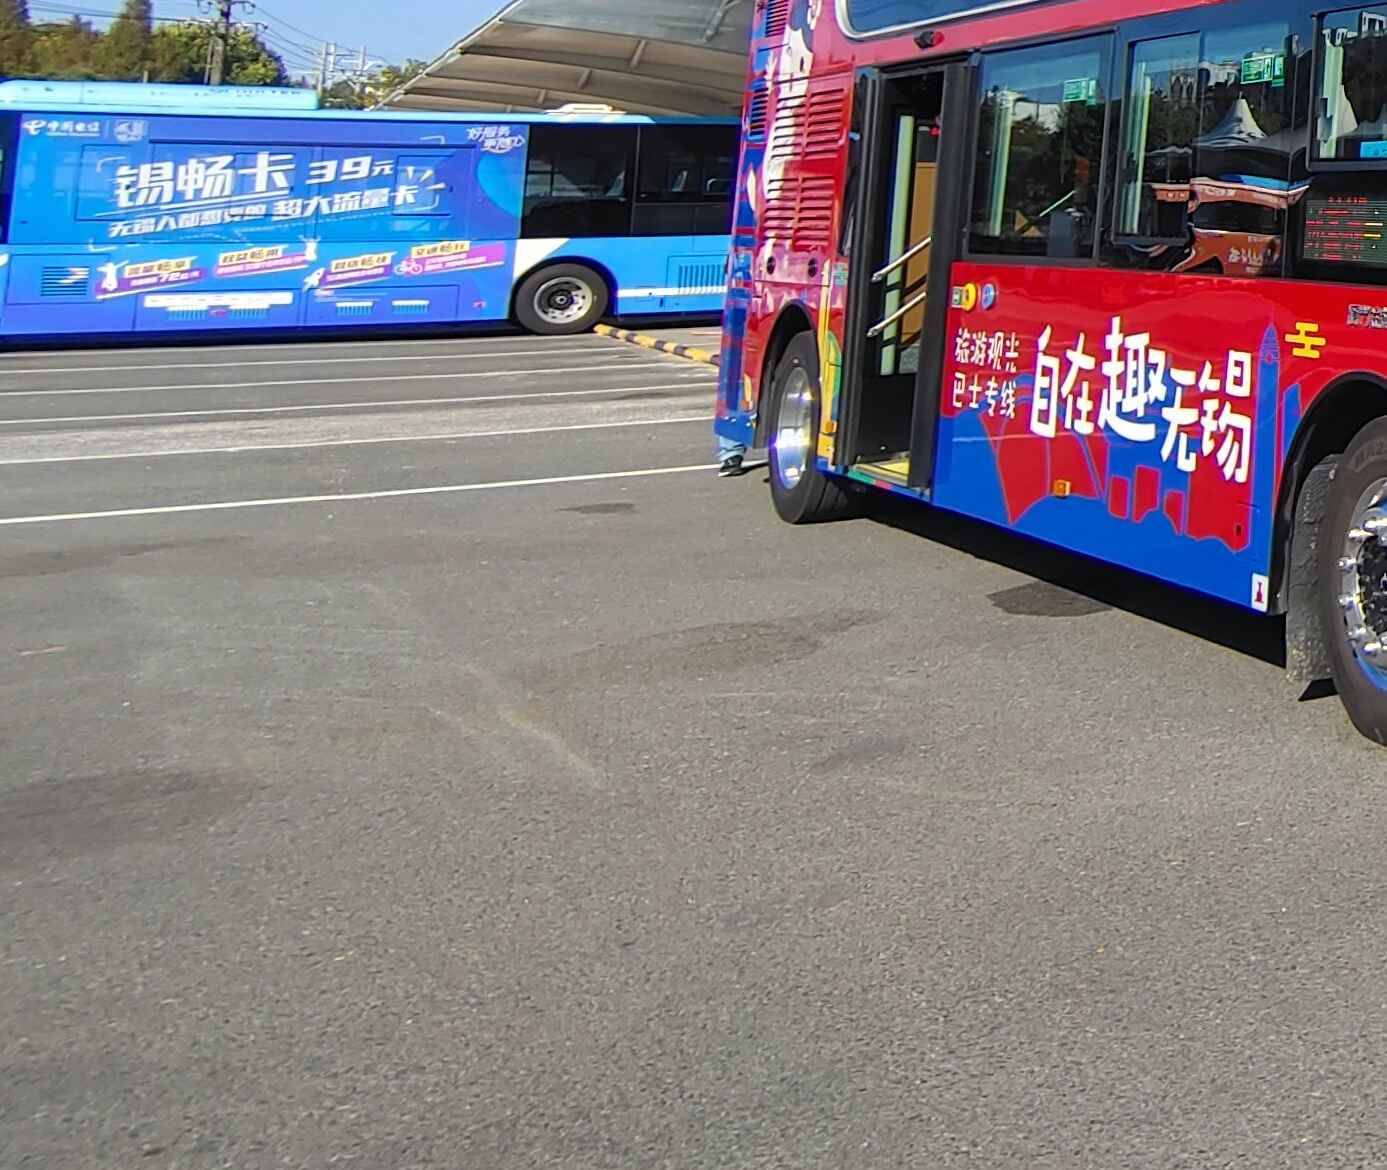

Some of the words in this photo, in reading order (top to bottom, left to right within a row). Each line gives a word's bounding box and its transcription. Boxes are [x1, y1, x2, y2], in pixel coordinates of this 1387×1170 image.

[114, 151, 297, 208] 锡畅卡
[272, 185, 419, 221] 超大流量卡
[955, 328, 1020, 373] 旅游观光
[952, 372, 1017, 419] 巴士专线
